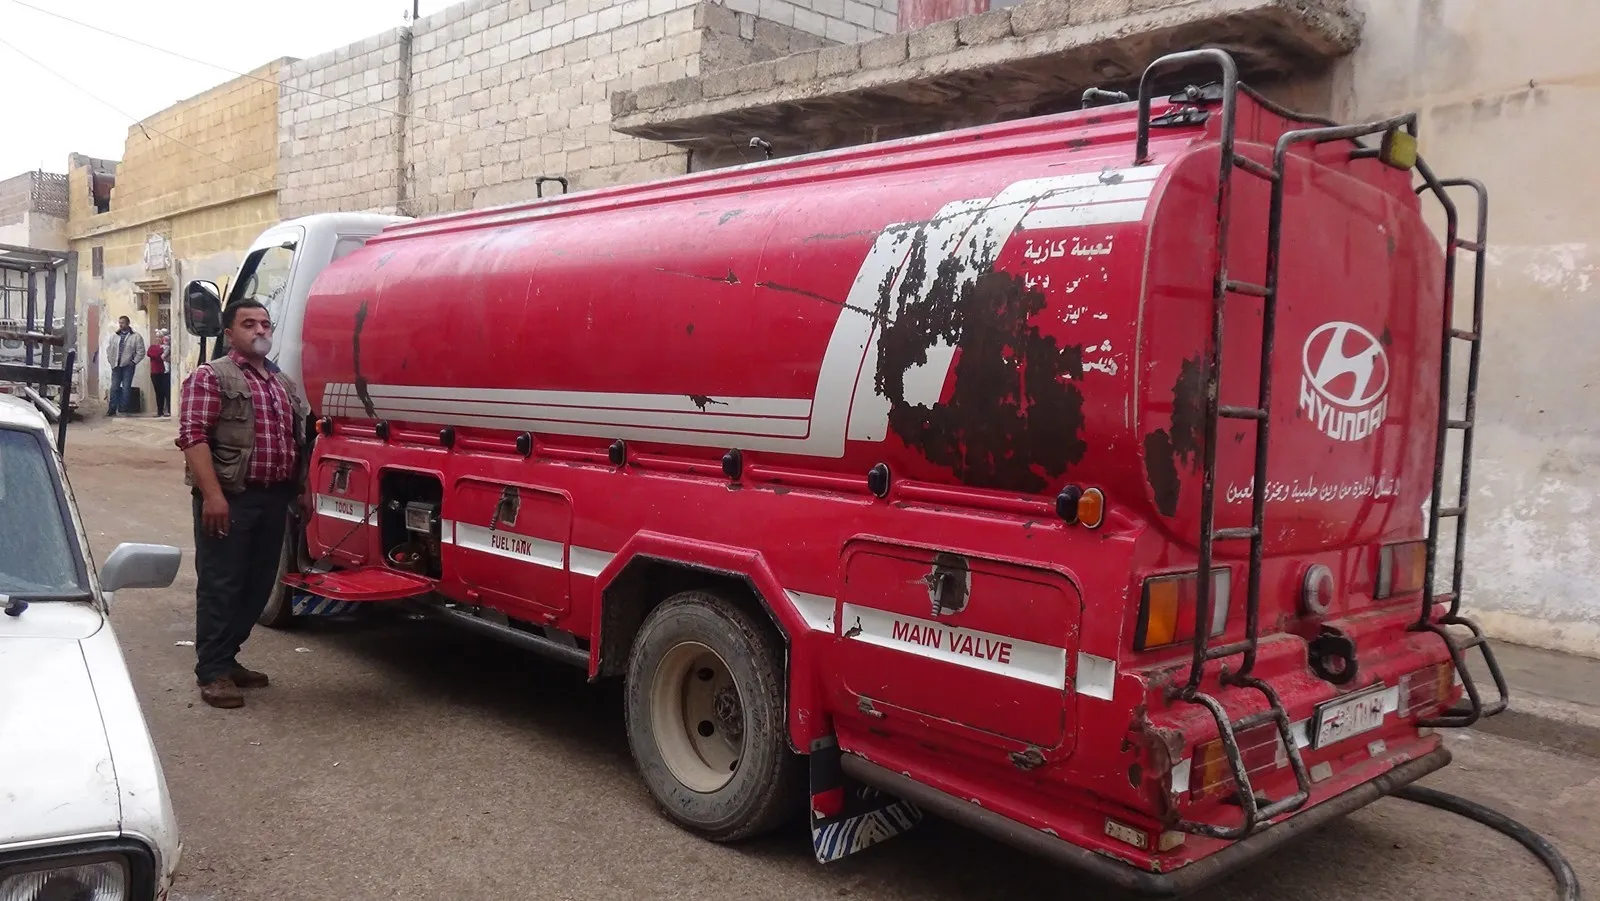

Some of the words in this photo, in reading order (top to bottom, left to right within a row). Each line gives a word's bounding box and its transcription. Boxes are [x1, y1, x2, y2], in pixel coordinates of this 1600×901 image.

[1024, 239, 1067, 265] كازية
[1300, 374, 1388, 441] HYUNDAI
[1226, 475, 1254, 504] لعين
[335, 501, 354, 515] TOOLS
[491, 534, 509, 551] FUEL
[512, 538, 532, 556] TANK
[892, 620, 943, 649] MAIN
[948, 631, 1013, 665] VALVE
